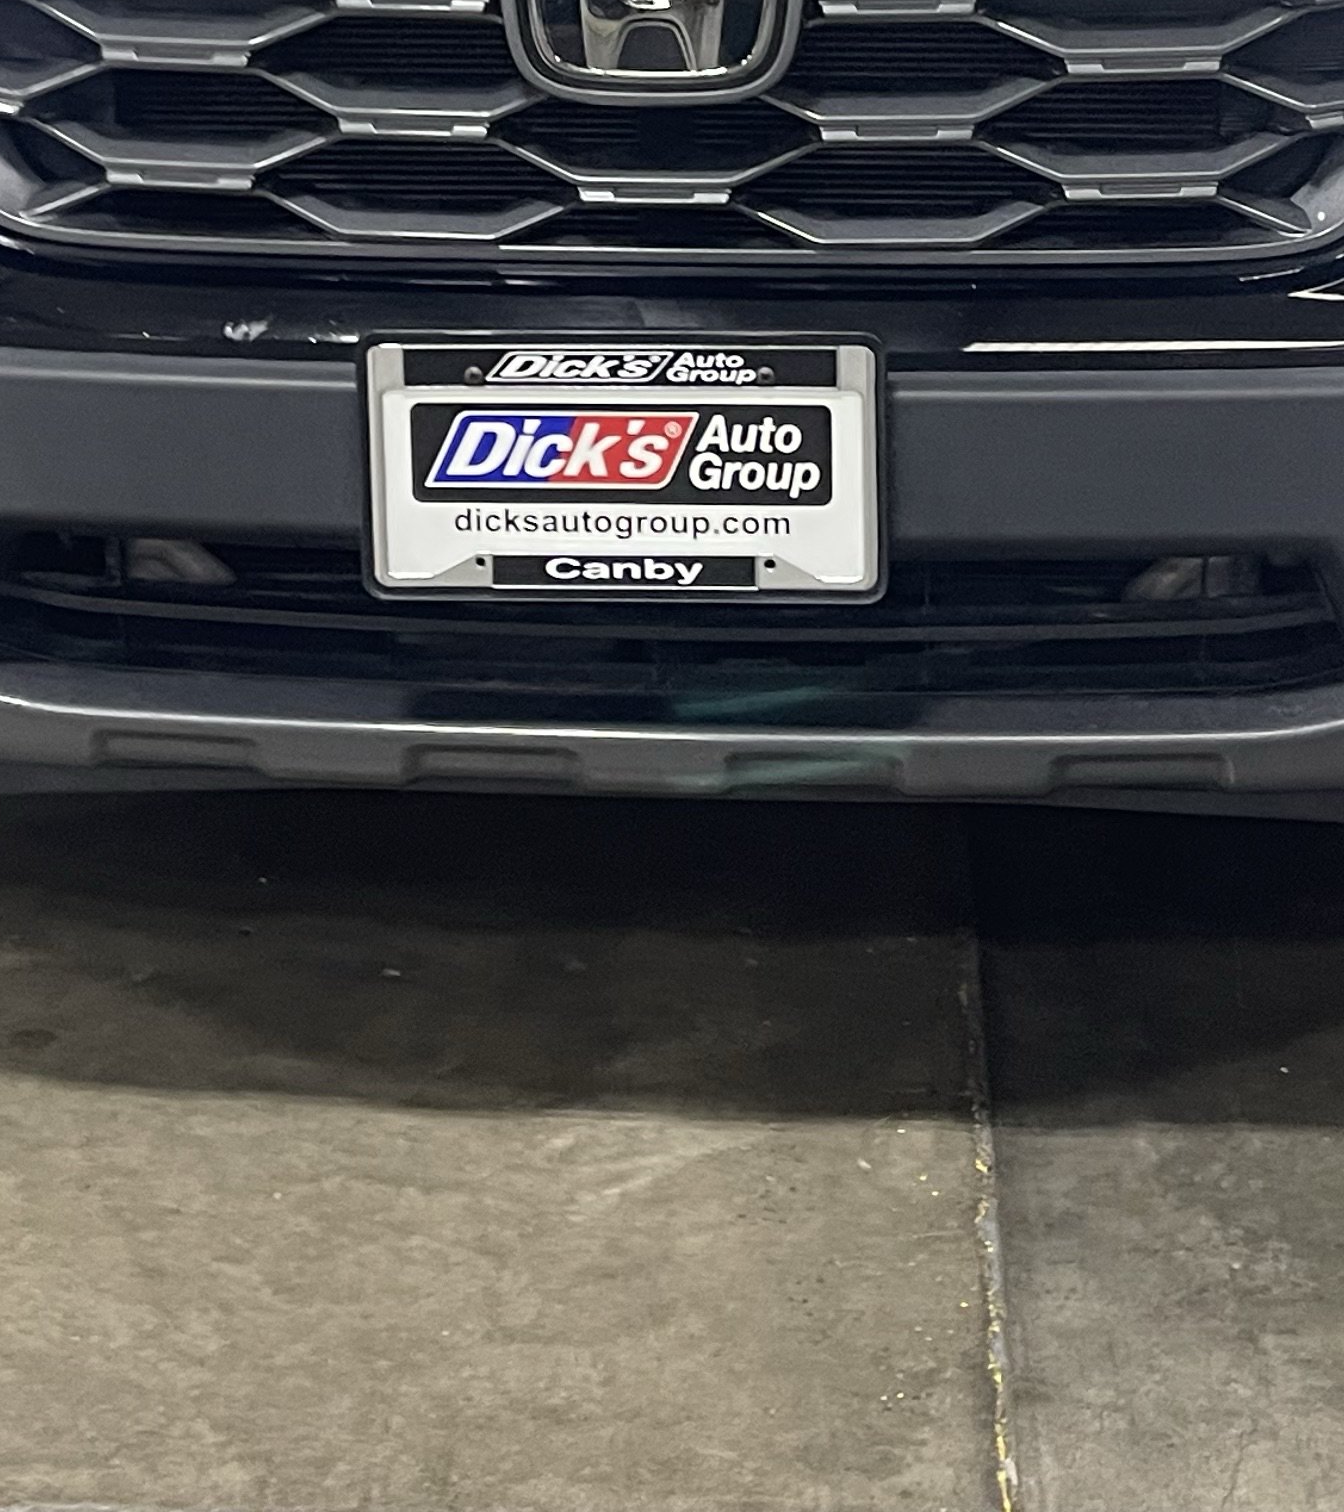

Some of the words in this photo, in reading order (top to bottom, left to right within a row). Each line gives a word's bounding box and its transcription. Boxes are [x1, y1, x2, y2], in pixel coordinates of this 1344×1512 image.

[498, 353, 656, 380] Dick's
[671, 351, 745, 369] Auto
[665, 366, 757, 386] Group
[445, 418, 670, 479] Dick's
[695, 413, 803, 454] Auto
[688, 452, 822, 499] Group
[454, 508, 792, 540] dicksautogroup.com
[544, 556, 704, 586] Canby
